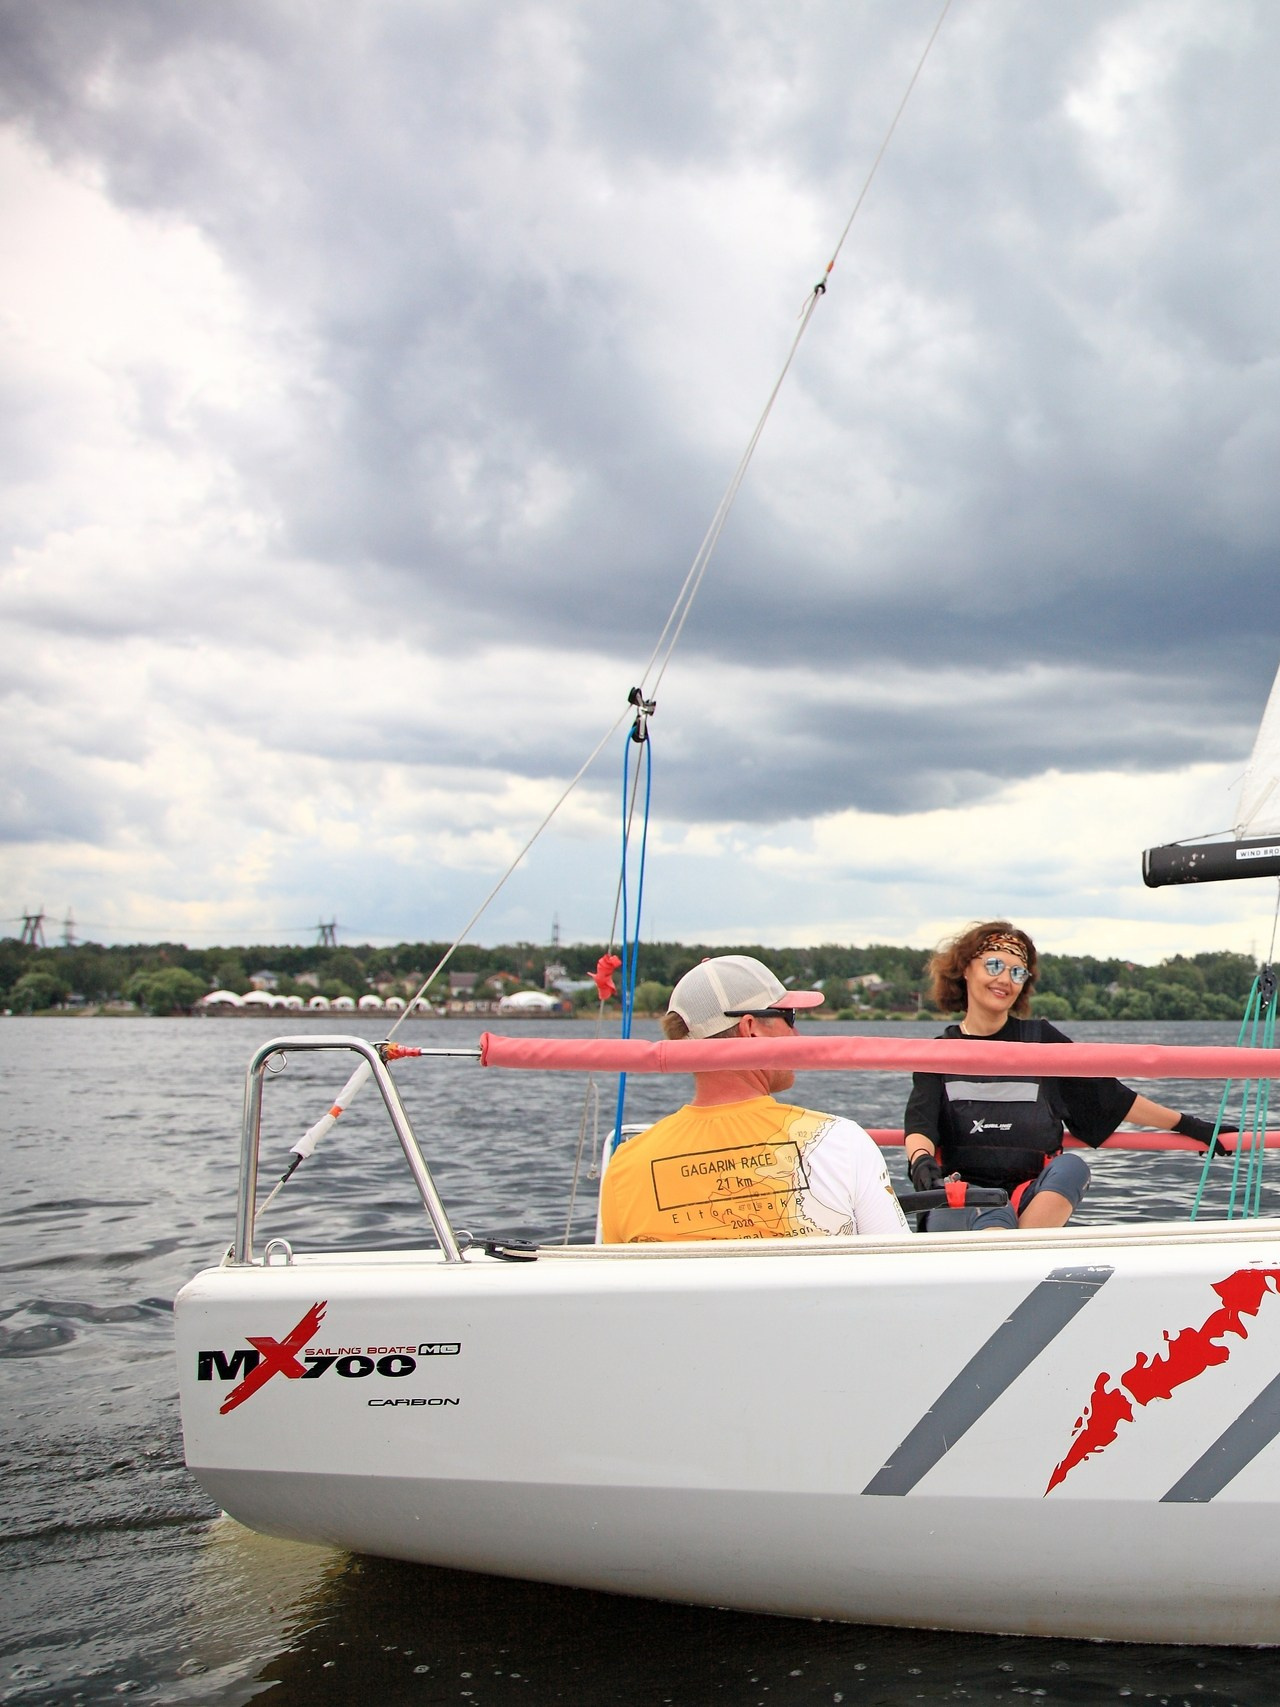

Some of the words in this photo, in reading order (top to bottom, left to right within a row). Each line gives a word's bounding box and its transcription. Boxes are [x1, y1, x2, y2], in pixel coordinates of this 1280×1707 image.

[1240, 850, 1261, 858] WIND
[681, 1159, 736, 1178] GAGARIN
[741, 1153, 773, 1169] RACE
[716, 1178, 730, 1191] 21
[737, 1177, 753, 1188] km
[672, 1208, 733, 1224] Elton
[753, 1197, 802, 1212] Lake
[730, 1218, 754, 1230] 2020
[305, 1347, 362, 1356] SAILING
[367, 1346, 417, 1354] BOATS
[368, 1398, 460, 1407] CARBON
